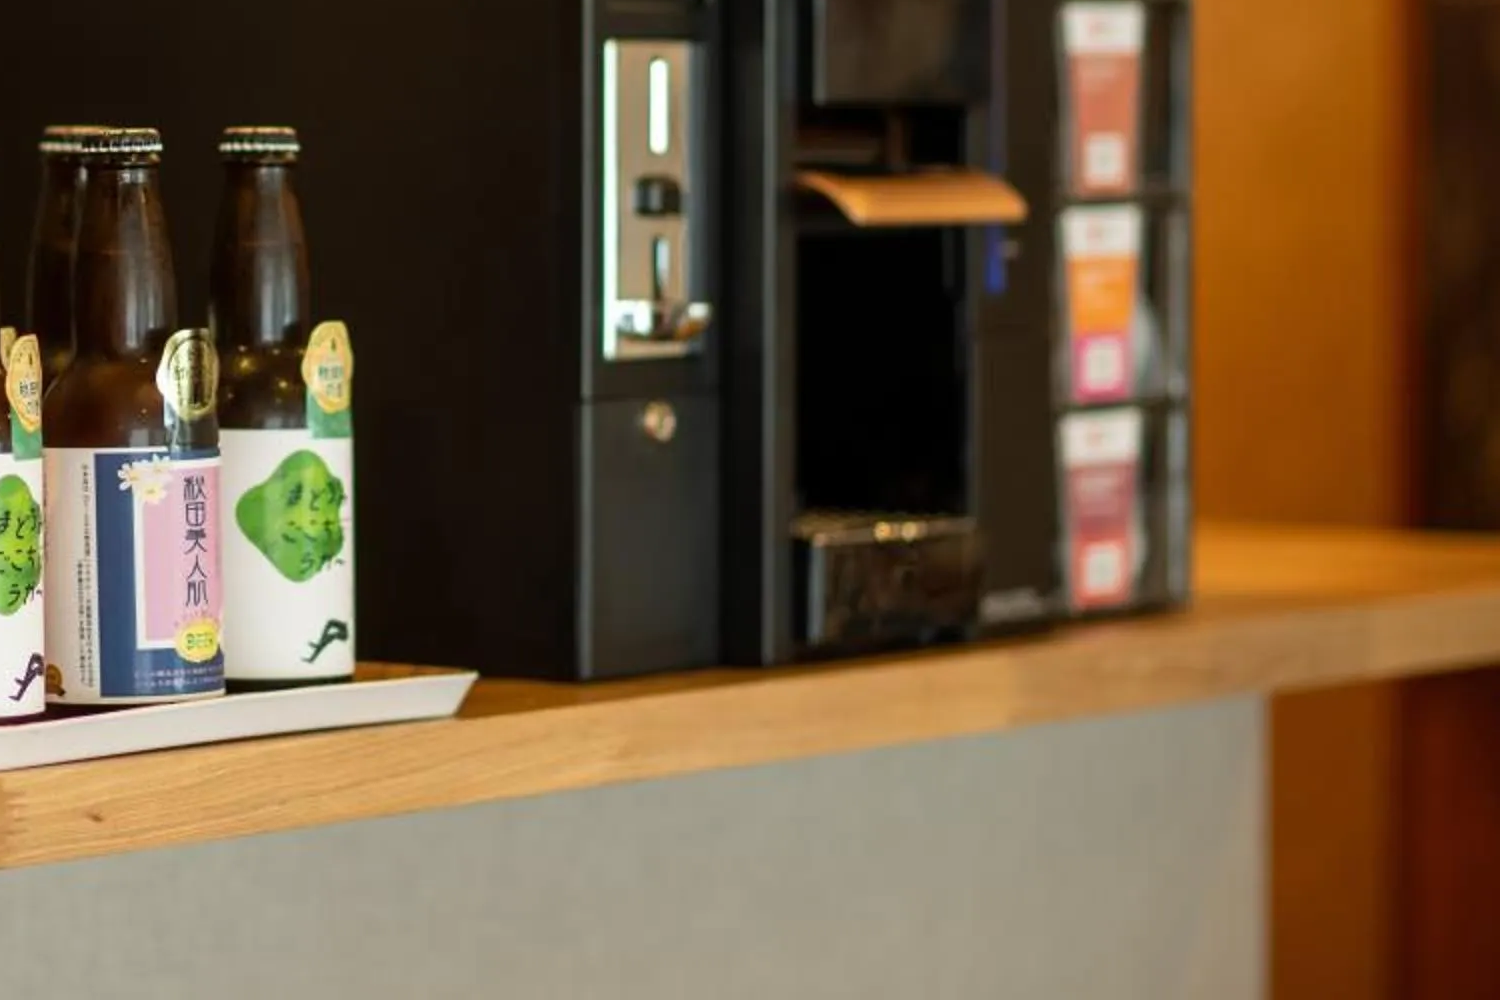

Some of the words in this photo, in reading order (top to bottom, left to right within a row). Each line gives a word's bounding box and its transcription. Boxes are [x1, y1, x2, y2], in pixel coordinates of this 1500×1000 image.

[183, 475, 209, 608] 秋田美人肌
